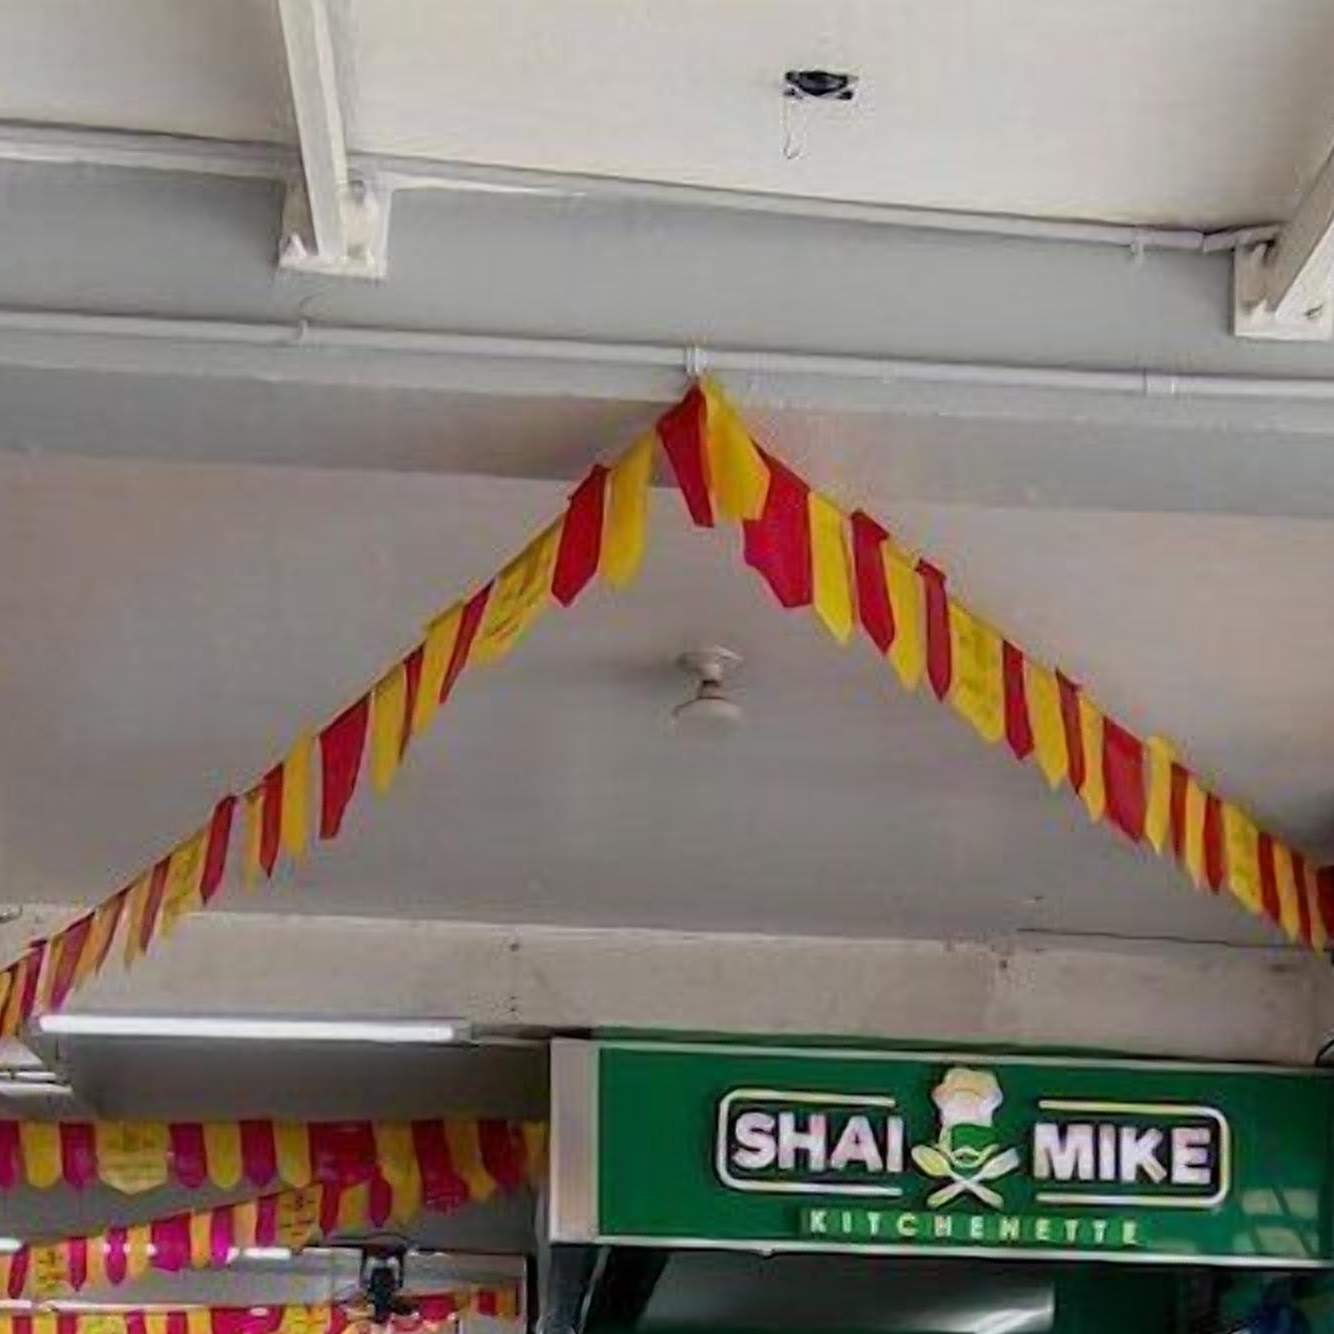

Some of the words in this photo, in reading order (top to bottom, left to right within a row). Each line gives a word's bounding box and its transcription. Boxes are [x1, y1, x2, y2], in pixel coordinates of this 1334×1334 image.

[733, 1112, 904, 1173] SHAI
[1033, 1122, 1212, 1185] MIKE
[809, 1209, 1140, 1246] KITCHENETTE
